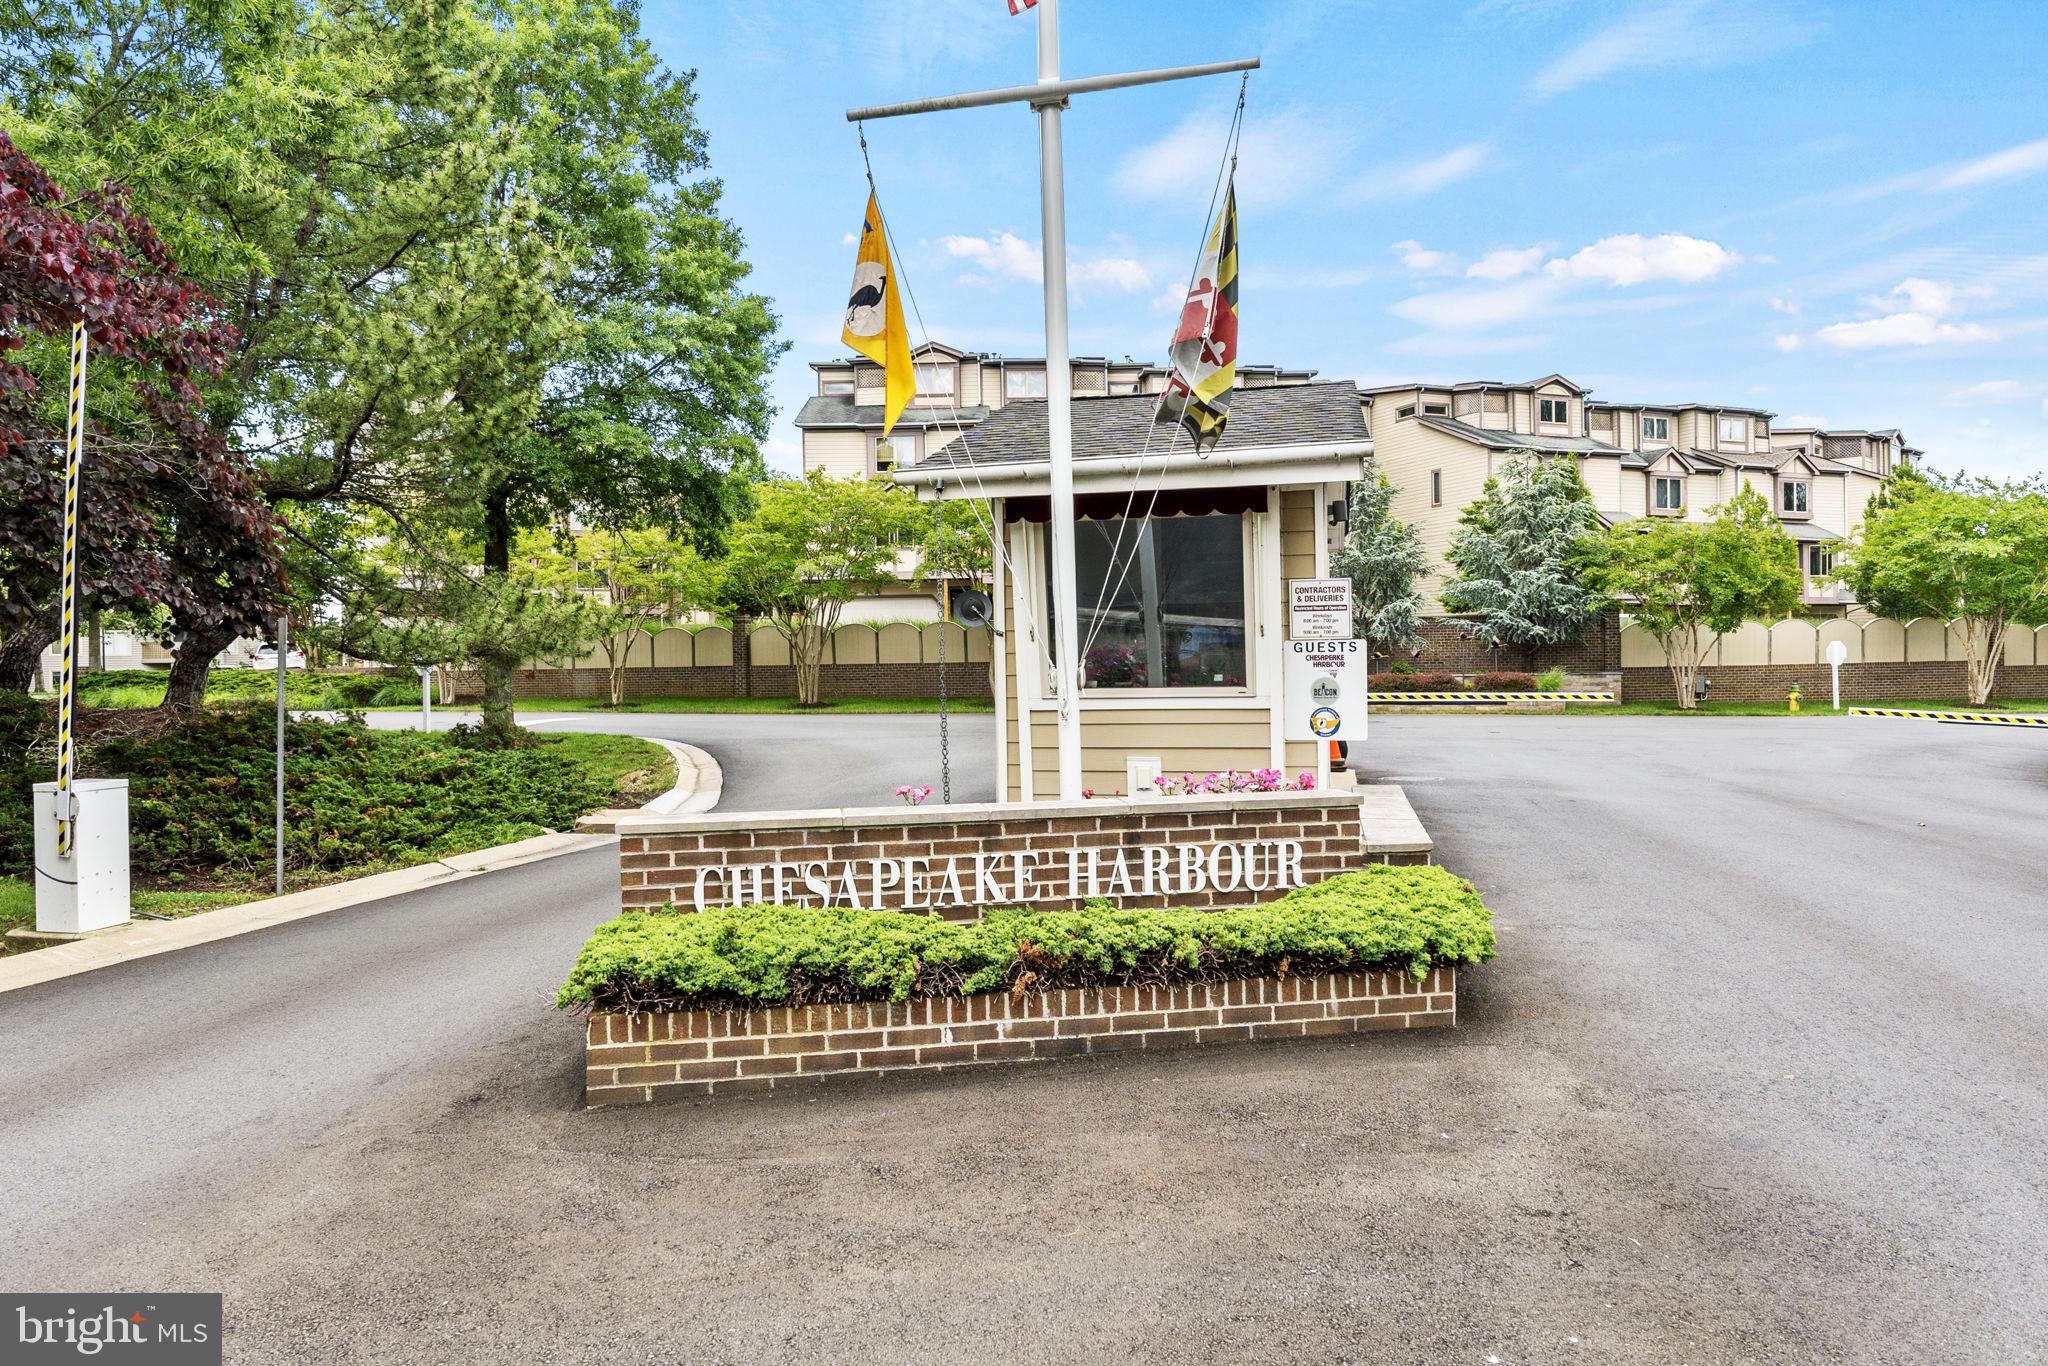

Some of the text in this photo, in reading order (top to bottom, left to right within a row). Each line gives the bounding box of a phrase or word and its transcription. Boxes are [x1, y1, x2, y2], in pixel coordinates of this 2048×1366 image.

[1304, 594, 1344, 602] DELIVERIES
[1293, 641, 1357, 653] GUESTS
[1313, 686, 1337, 696] BEACON
[693, 841, 1307, 913] CHESAPEAKE HARBOUR
